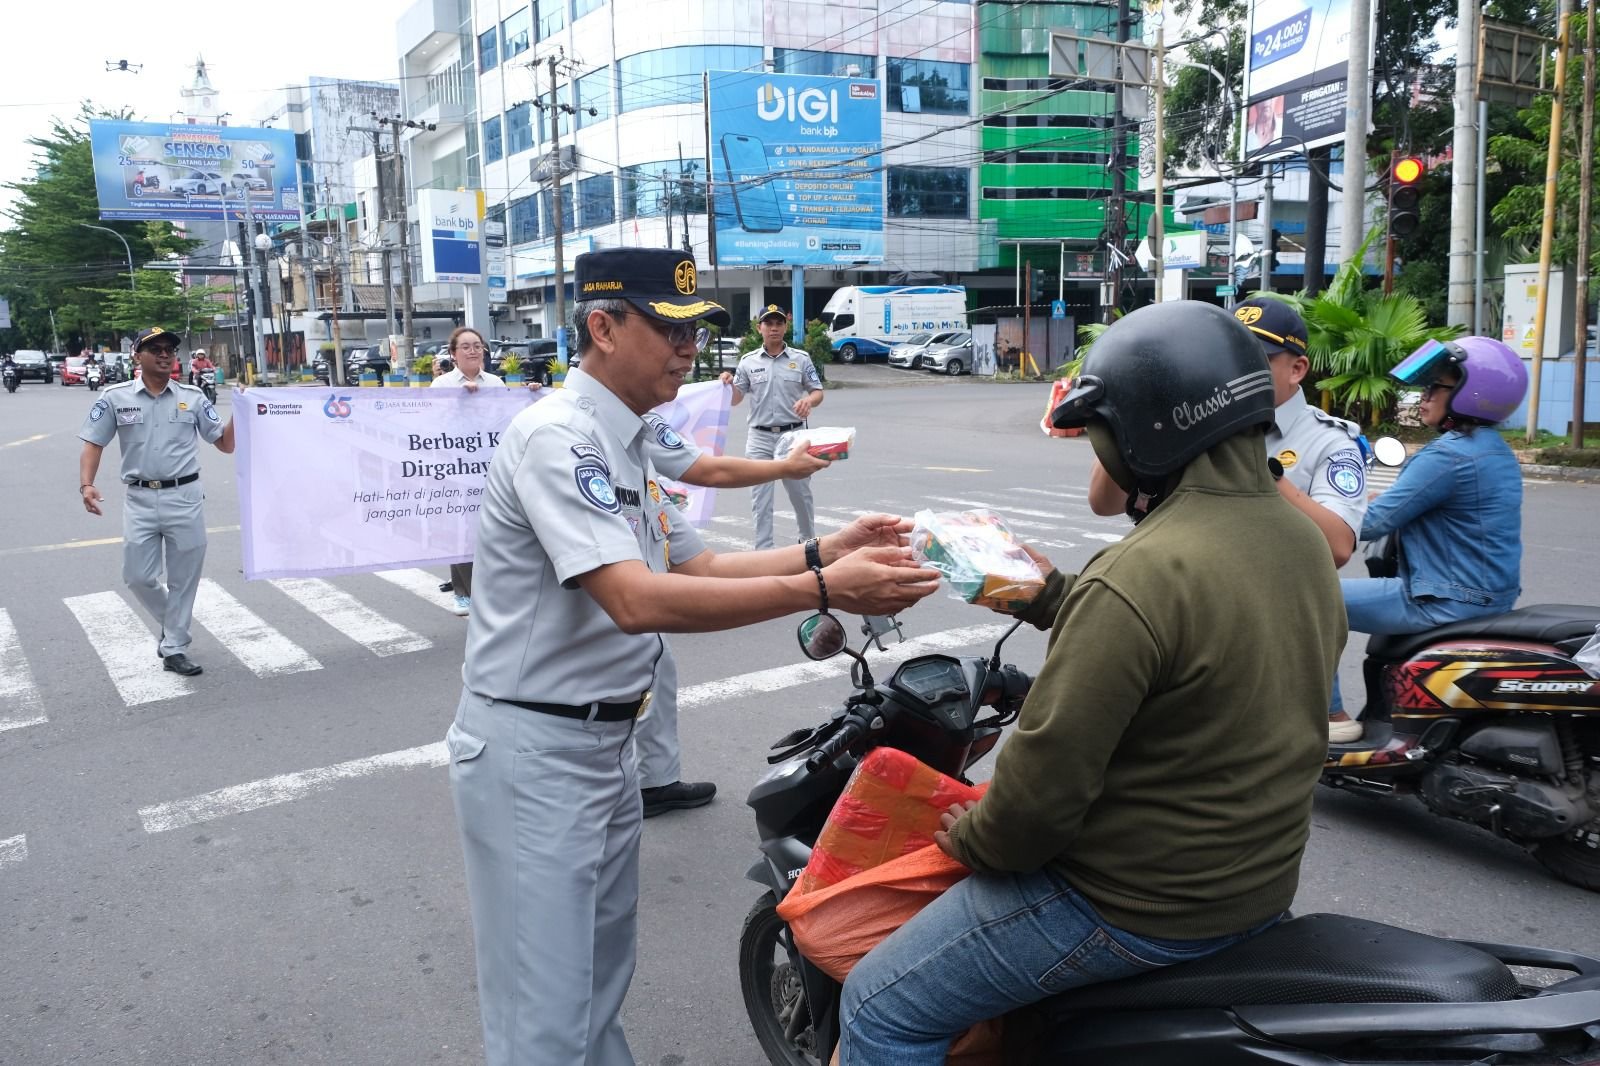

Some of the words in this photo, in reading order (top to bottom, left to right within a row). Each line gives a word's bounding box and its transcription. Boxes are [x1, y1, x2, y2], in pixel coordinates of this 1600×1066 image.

[800, 125, 823, 136] bank
[823, 126, 839, 138] bjb
[163, 142, 231, 160] SENSASI
[798, 146, 839, 154] TANDAMATA
[118, 156, 132, 166] 25
[241, 160, 255, 169] 50
[134, 184, 143, 196] 6
[435, 216, 457, 227] bank
[458, 217, 474, 230] bjb
[595, 281, 623, 291] RAHARJA
[323, 393, 352, 418] 65
[385, 401, 400, 409] JASA
[1172, 387, 1231, 431] Classic
[408, 432, 483, 453] Berbagi
[353, 489, 410, 503] Hati-hati
[413, 488, 425, 499] di
[428, 487, 463, 504] jalan,
[365, 507, 411, 522] jangan
[415, 504, 443, 519] lupa
[446, 503, 481, 519] bayar
[1498, 680, 1593, 692] SCOOPY
